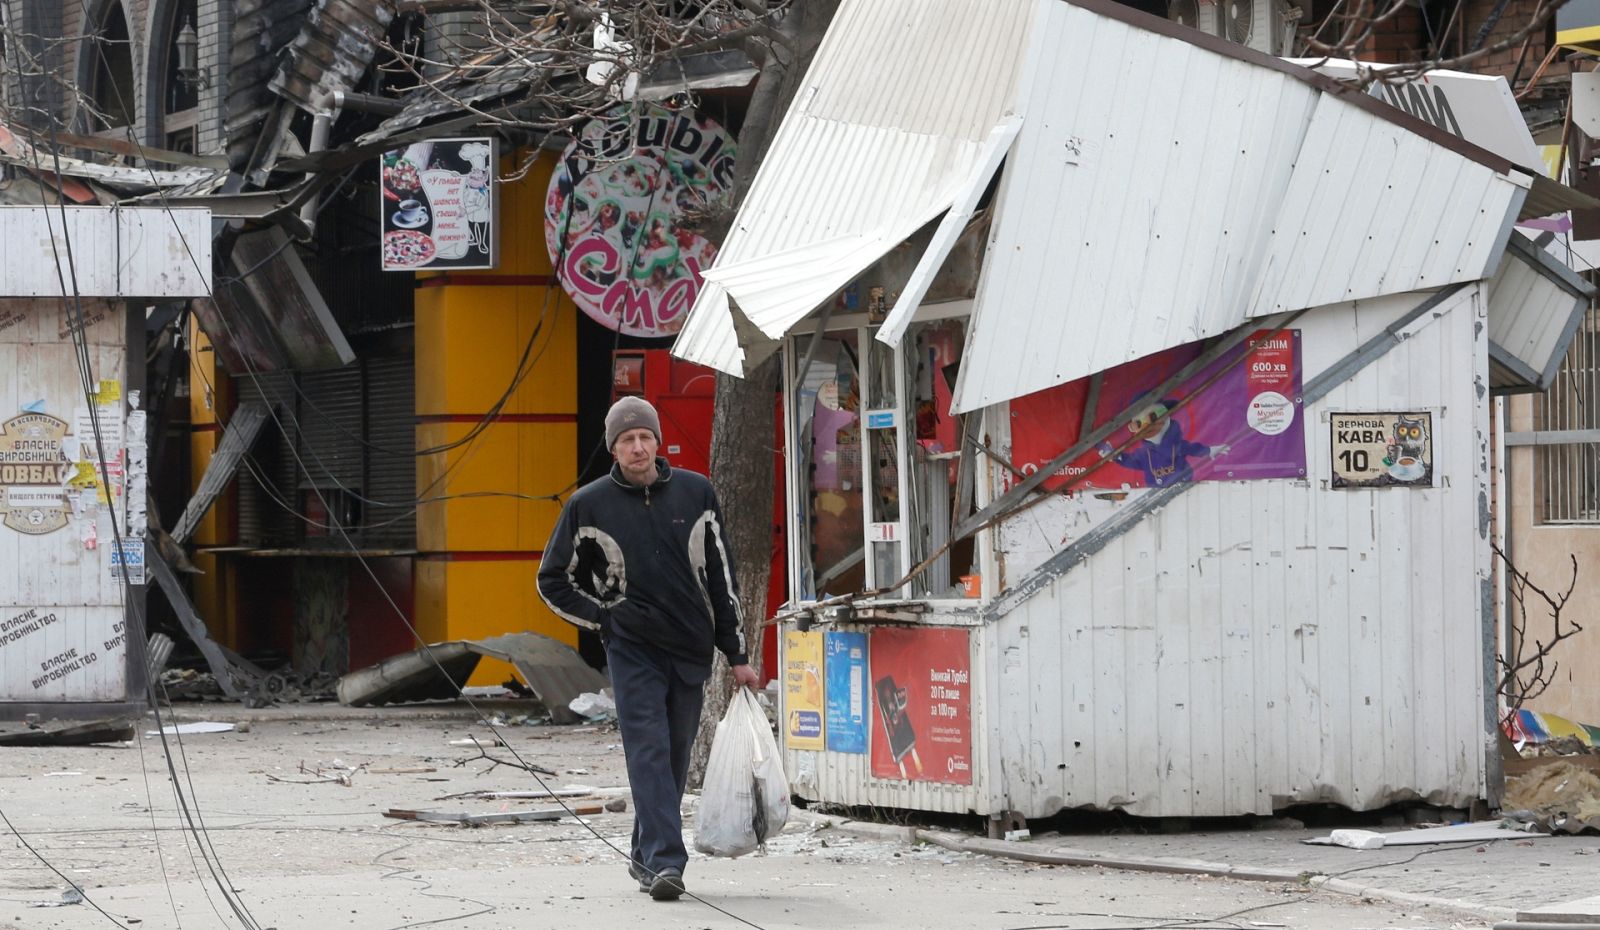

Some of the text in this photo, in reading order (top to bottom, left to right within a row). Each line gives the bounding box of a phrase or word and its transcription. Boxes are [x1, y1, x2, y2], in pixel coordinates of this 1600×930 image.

[1252, 362, 1286, 372] 600 хв
[1338, 421, 1385, 429] ЗЕРНОВА
[1338, 430, 1386, 444] КАВА
[15, 440, 57, 450] ВЛАСНЕ
[1338, 449, 1369, 473] 10
[1, 608, 37, 633] ВЛАСНЕ
[41, 648, 78, 671] ВЛАСНЕ
[32, 652, 97, 689] ВИРОБНИЦТВО
[930, 685, 937, 699] 20
[938, 702, 947, 716] 100
